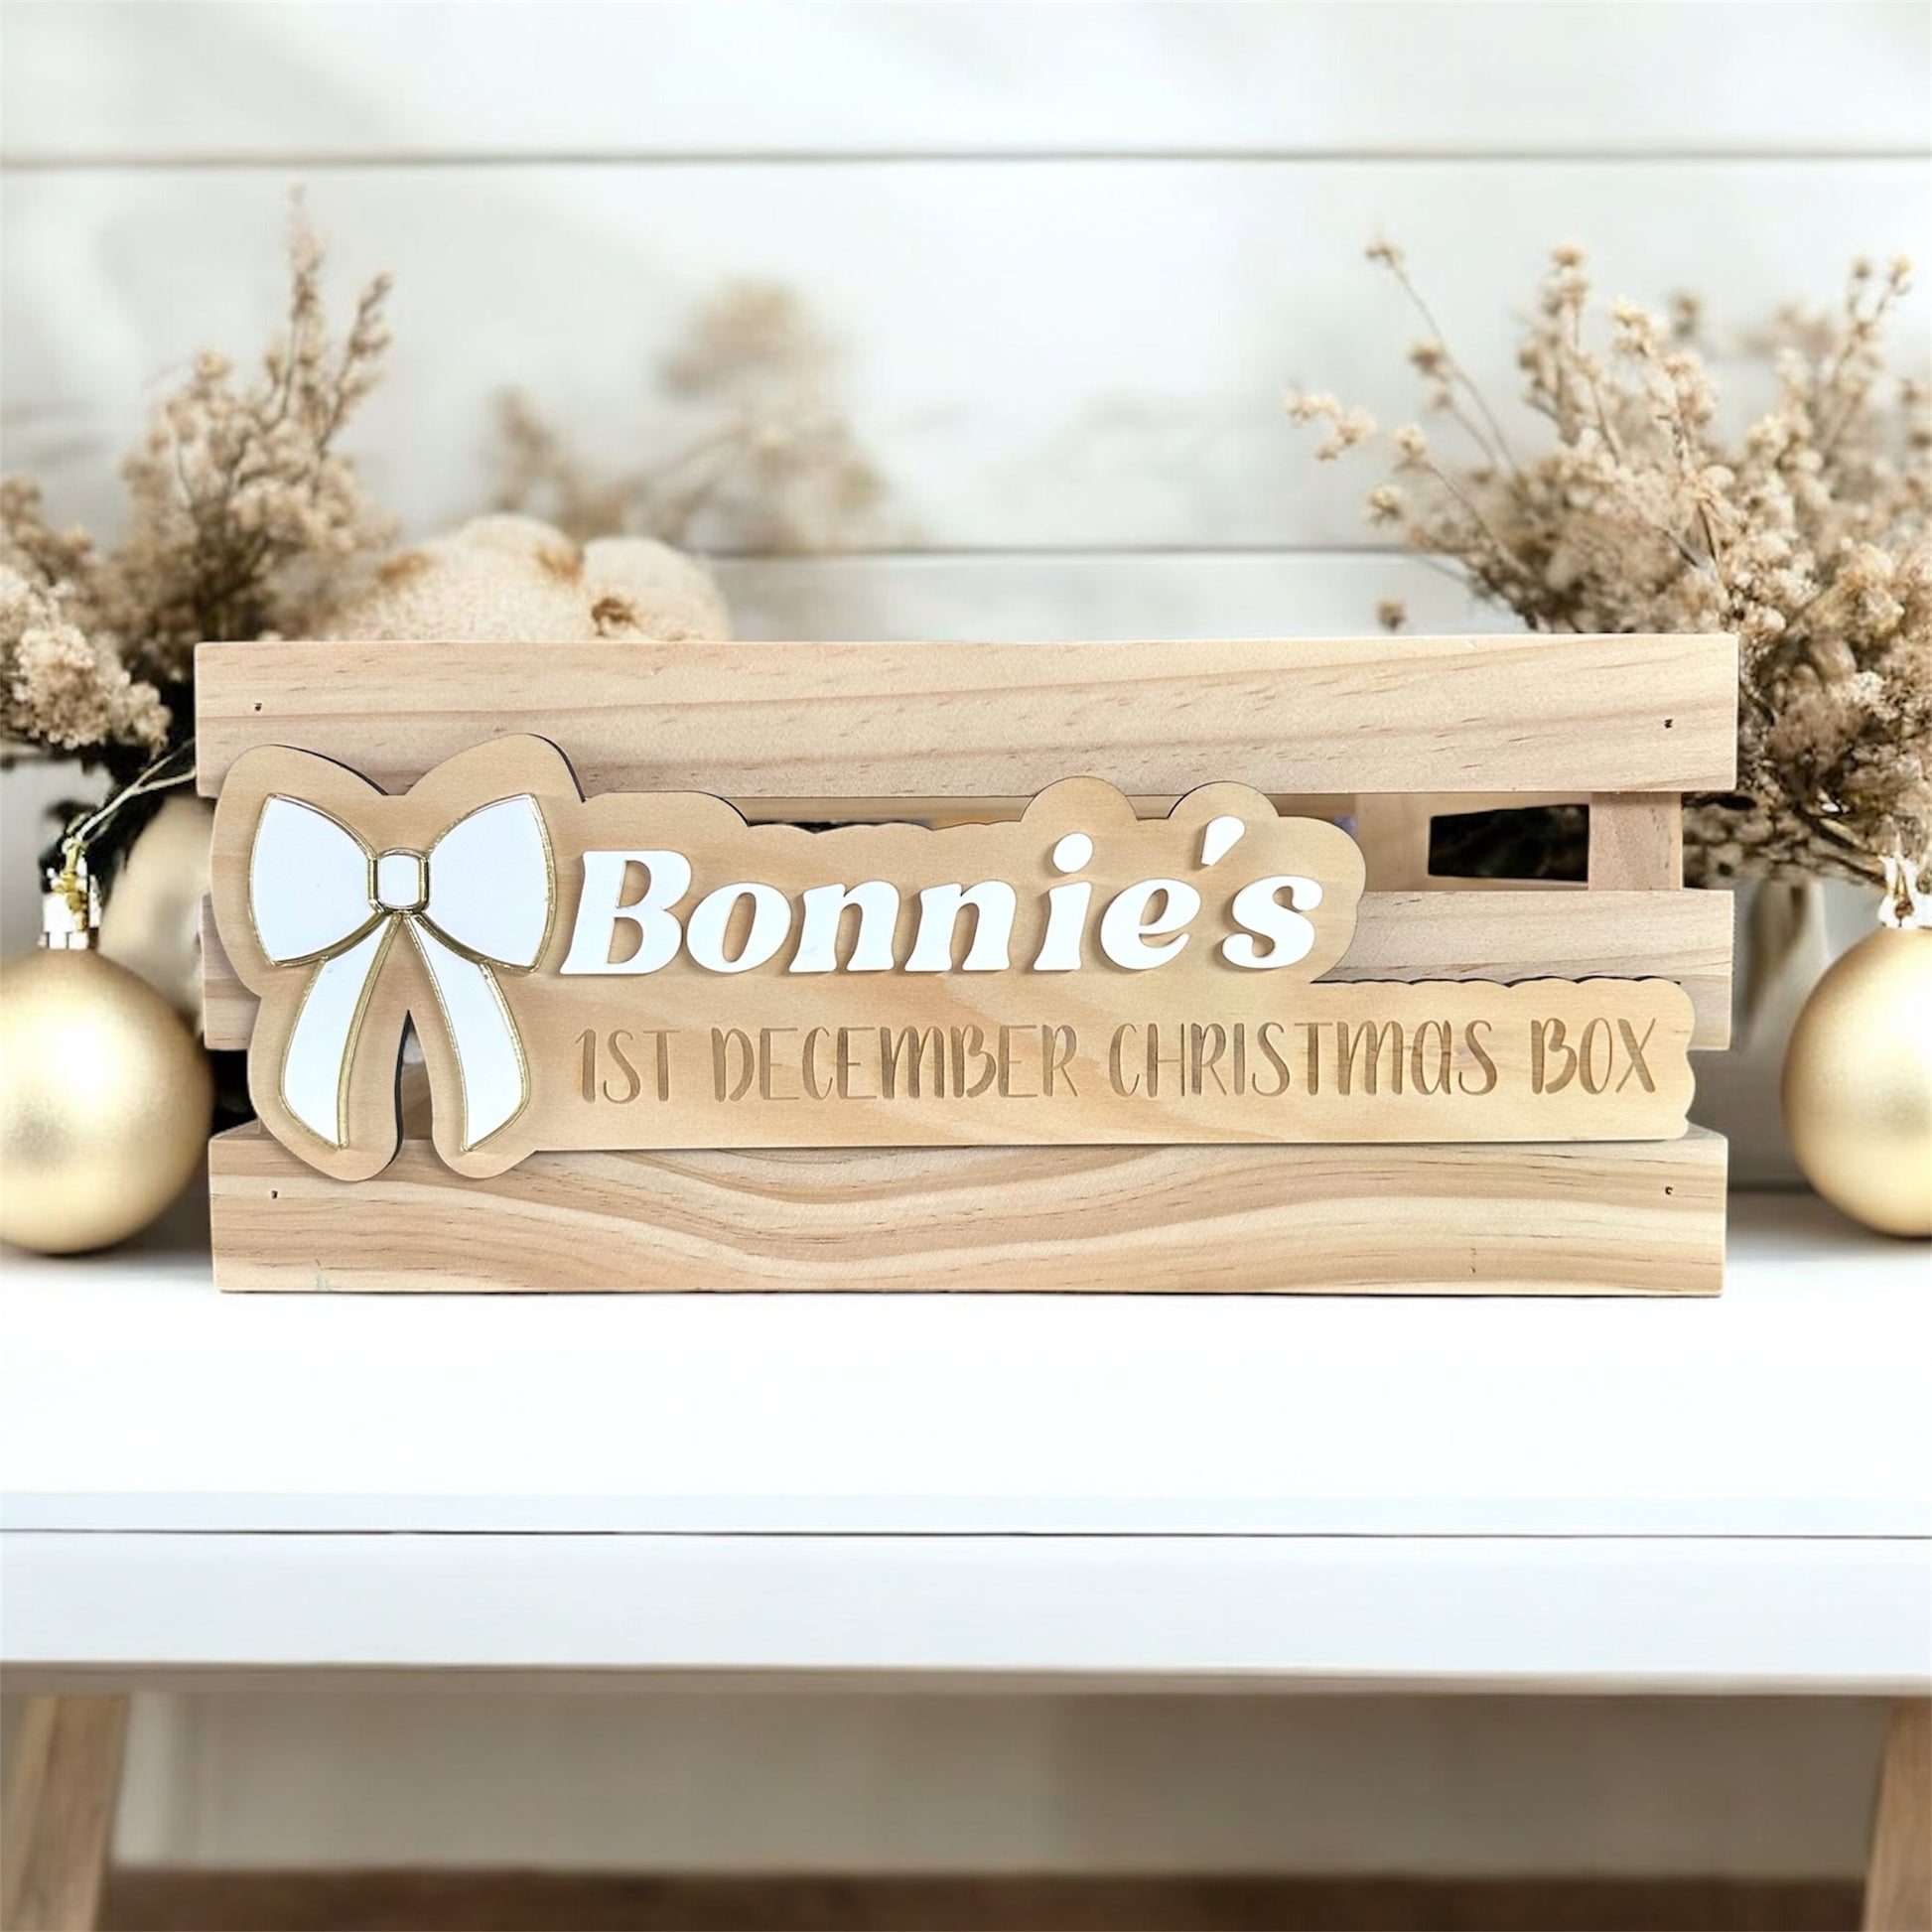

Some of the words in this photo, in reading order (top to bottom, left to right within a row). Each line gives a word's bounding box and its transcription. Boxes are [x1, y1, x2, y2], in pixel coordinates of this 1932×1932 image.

[560, 816, 1323, 975] Bonnie's
[576, 1027, 681, 1104] 1ST
[712, 1023, 1079, 1102] DECEMBER
[1108, 1020, 1498, 1097] CHRISTMAS
[1531, 1017, 1657, 1095] BOX
